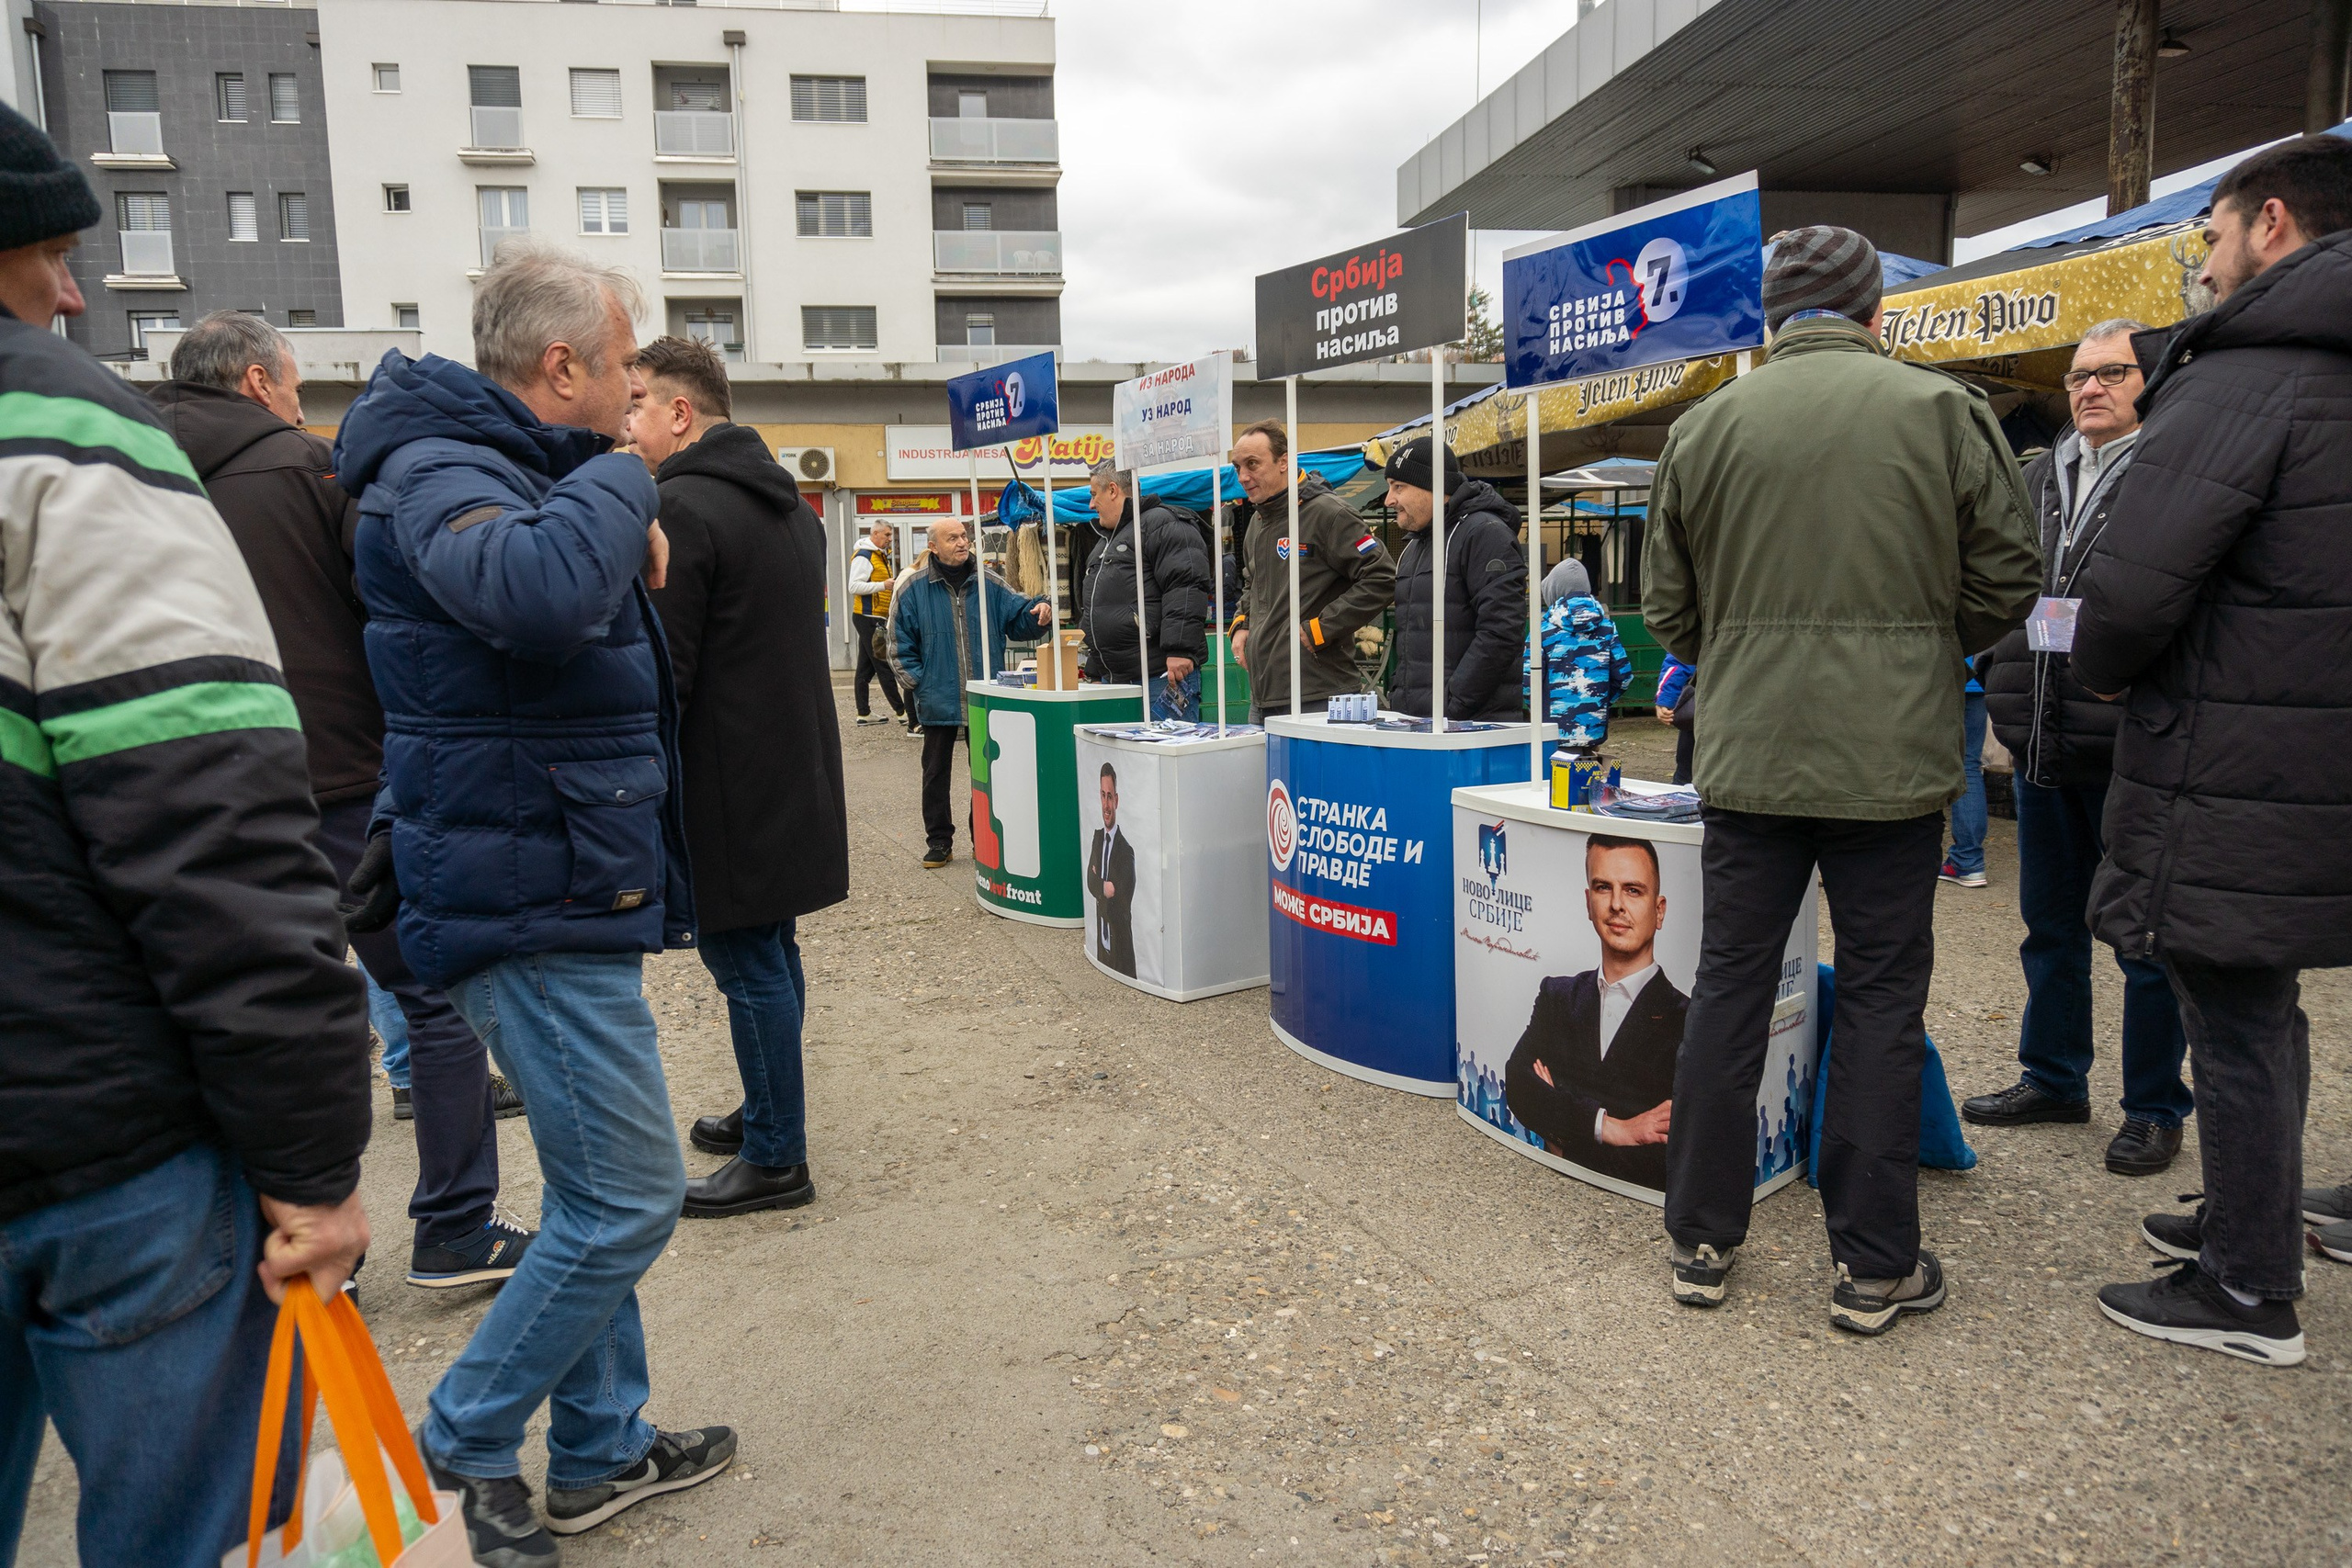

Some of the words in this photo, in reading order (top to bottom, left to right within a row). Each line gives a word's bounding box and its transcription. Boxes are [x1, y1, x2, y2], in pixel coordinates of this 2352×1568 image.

[1311, 248, 1403, 302] Србија
[1647, 255, 1679, 307] 7.
[1317, 292, 1398, 335] против
[1549, 290, 1625, 321] СРБИЈА
[1550, 308, 1625, 338] ПРОТИВ
[1882, 304, 1970, 356] Jelen
[1974, 289, 2057, 343] Pivo
[1317, 325, 1399, 360] насиља
[1550, 325, 1630, 355] НАСИЉА
[1139, 376, 1152, 390] ИЗ
[1155, 363, 1195, 387] НАРОДА
[1577, 375, 1630, 415] Jelen
[1631, 364, 1686, 402] Pivo
[975, 398, 1004, 412] СРБИЈА
[1010, 381, 1023, 409] 7.
[1142, 407, 1153, 422] УЗ
[1156, 398, 1192, 419] НАРОД
[976, 407, 1005, 422] ПРОТИВ
[977, 417, 1007, 432] НАСИЉА
[899, 448, 969, 459] INDUSTRIJA
[974, 448, 1008, 459] MESA
[1014, 434, 1115, 462] Matije
[1143, 444, 1155, 458] ЗА
[1158, 434, 1194, 456] НАРОД
[1297, 795, 1387, 832] СТРАНКА
[1297, 823, 1397, 864] СЛОБОДЕ
[1403, 840, 1424, 864] И
[1297, 851, 1372, 888] ПРАВДЕ
[1463, 877, 1490, 900] НОВО
[1496, 888, 1532, 913] ЛИЦЕ
[1273, 886, 1306, 919] МОЖЕ
[1309, 903, 1390, 940] СРБИЈА
[1469, 898, 1523, 933] СРБИЈЕ
[1782, 956, 1803, 979] ИЦЕ
